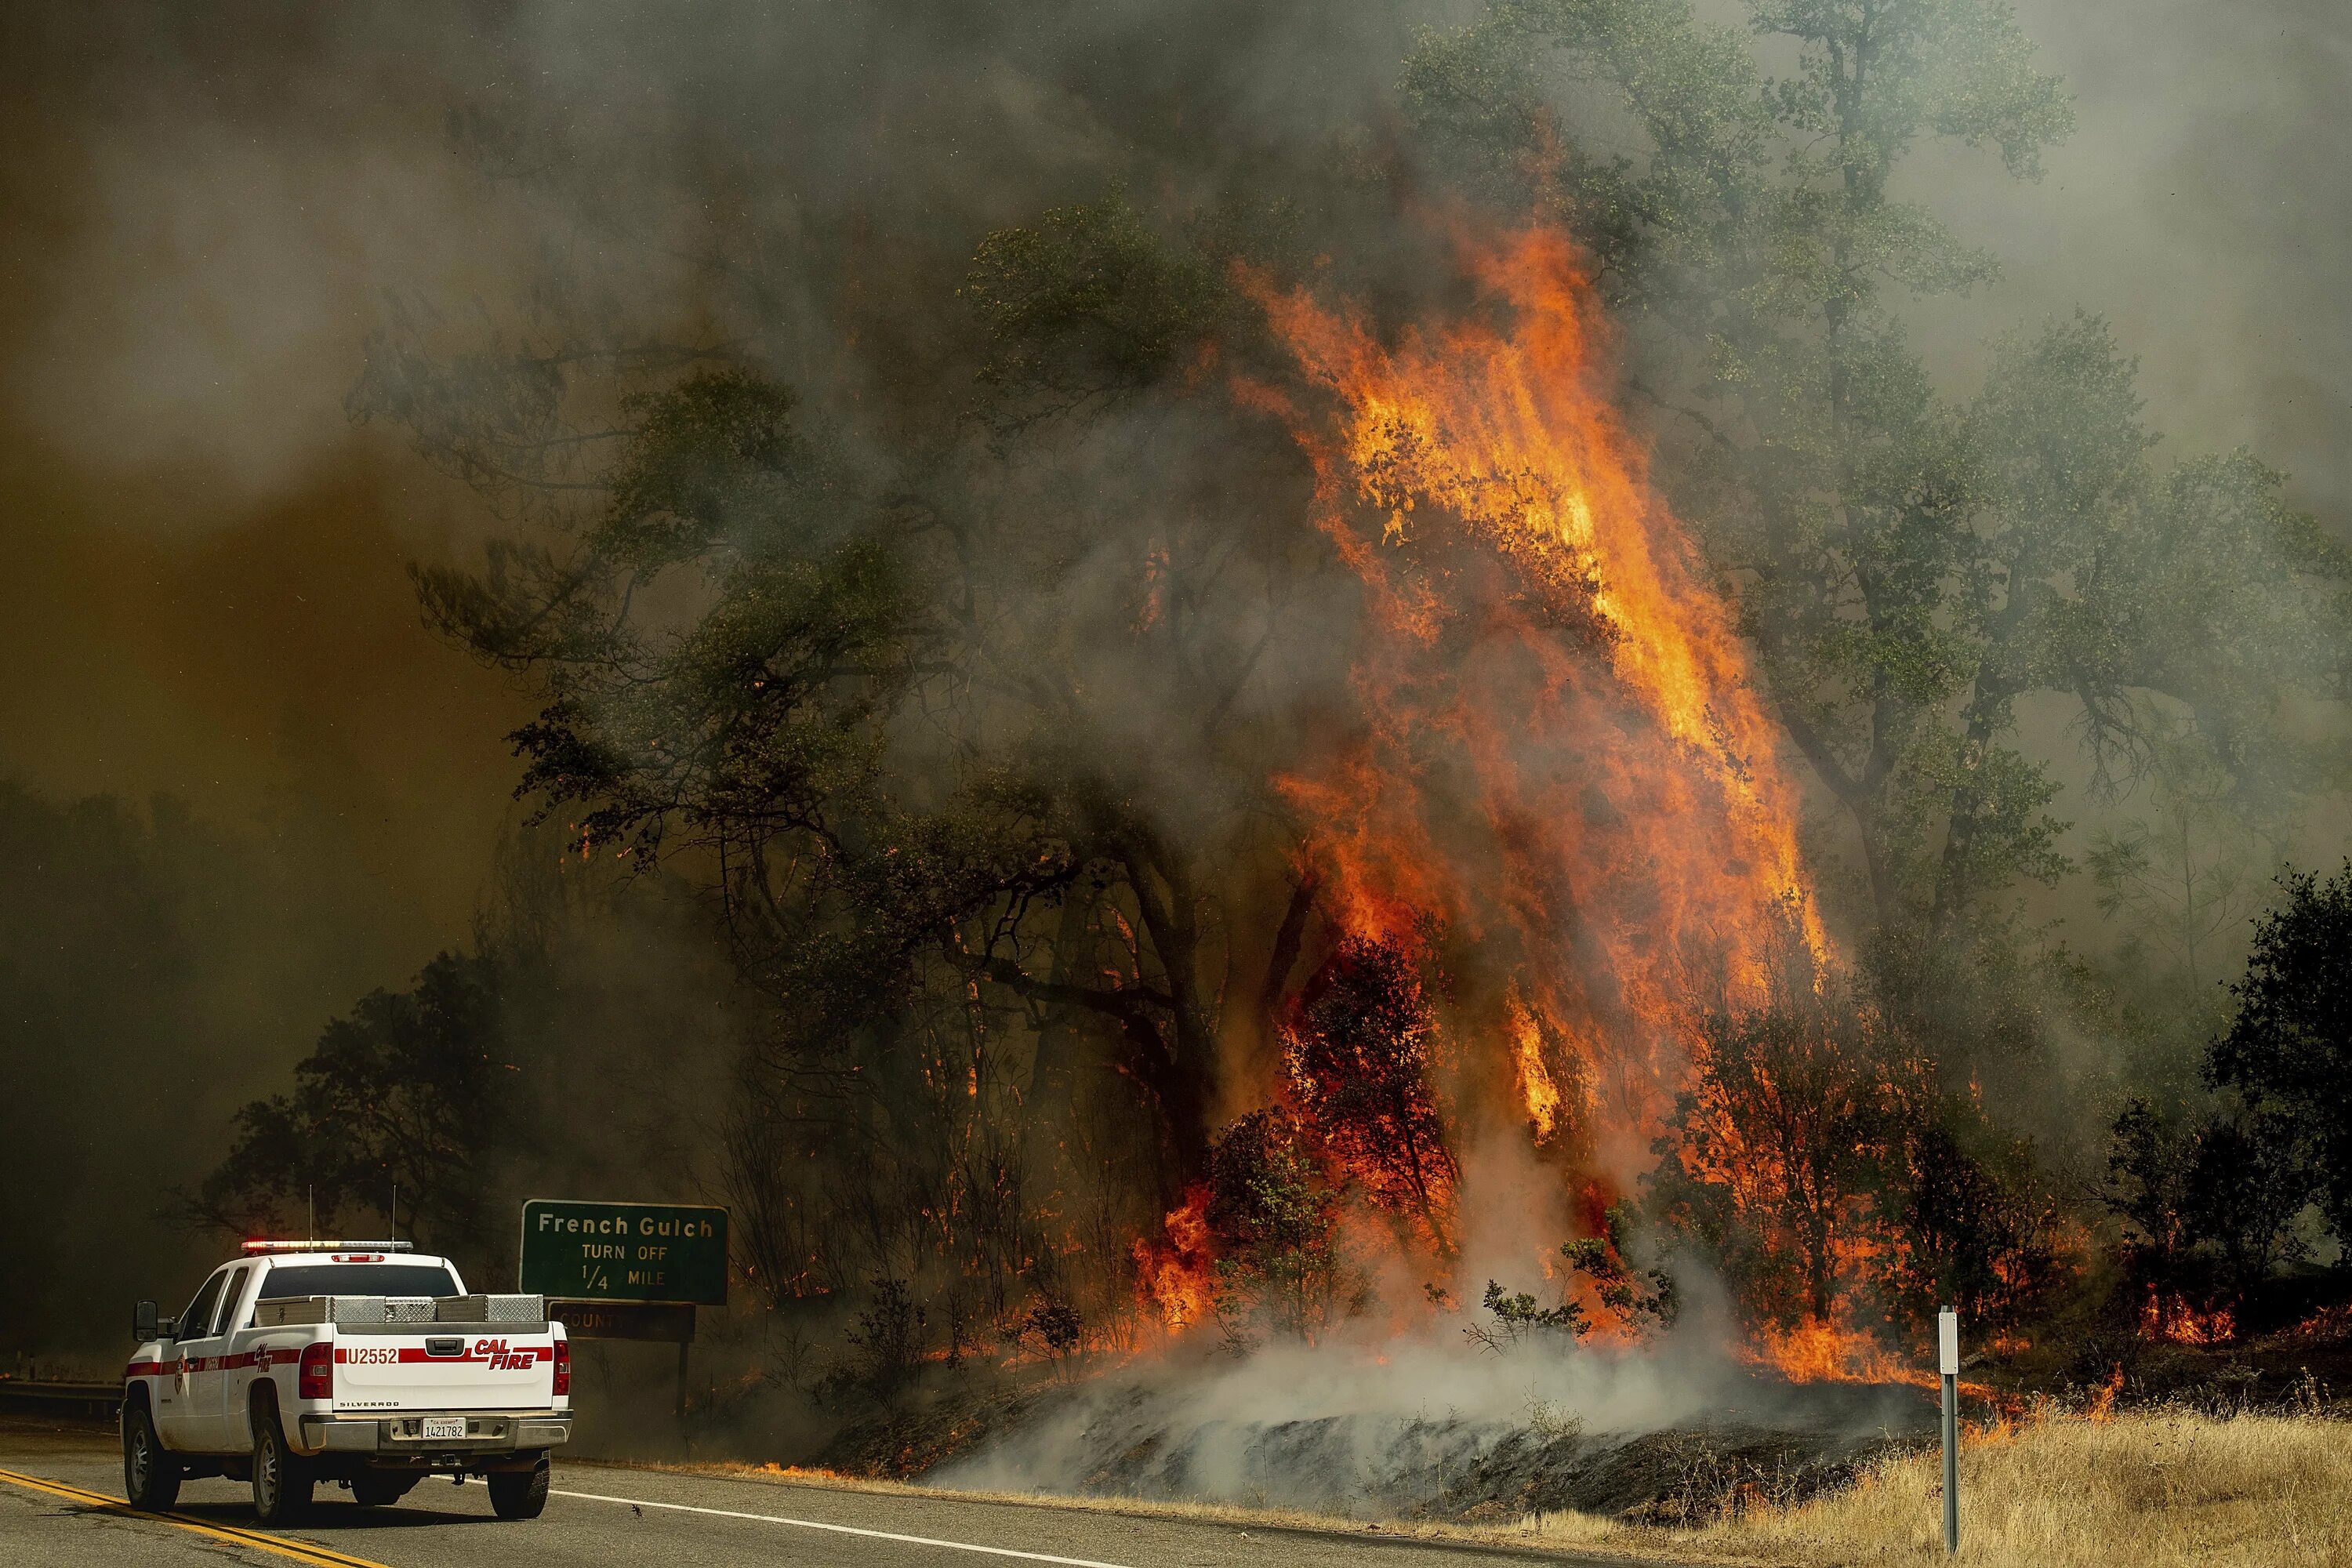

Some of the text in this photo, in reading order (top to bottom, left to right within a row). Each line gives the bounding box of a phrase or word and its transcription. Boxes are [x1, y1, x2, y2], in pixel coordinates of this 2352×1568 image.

[539, 1214, 713, 1238] French Gulch
[582, 1244, 668, 1261] TURN OFF
[583, 1265, 666, 1290] 1/4 MILE
[474, 1338, 511, 1355] CAL
[348, 1348, 397, 1365] U2552
[488, 1353, 535, 1370] FIRE
[426, 1425, 463, 1438] 1421782
